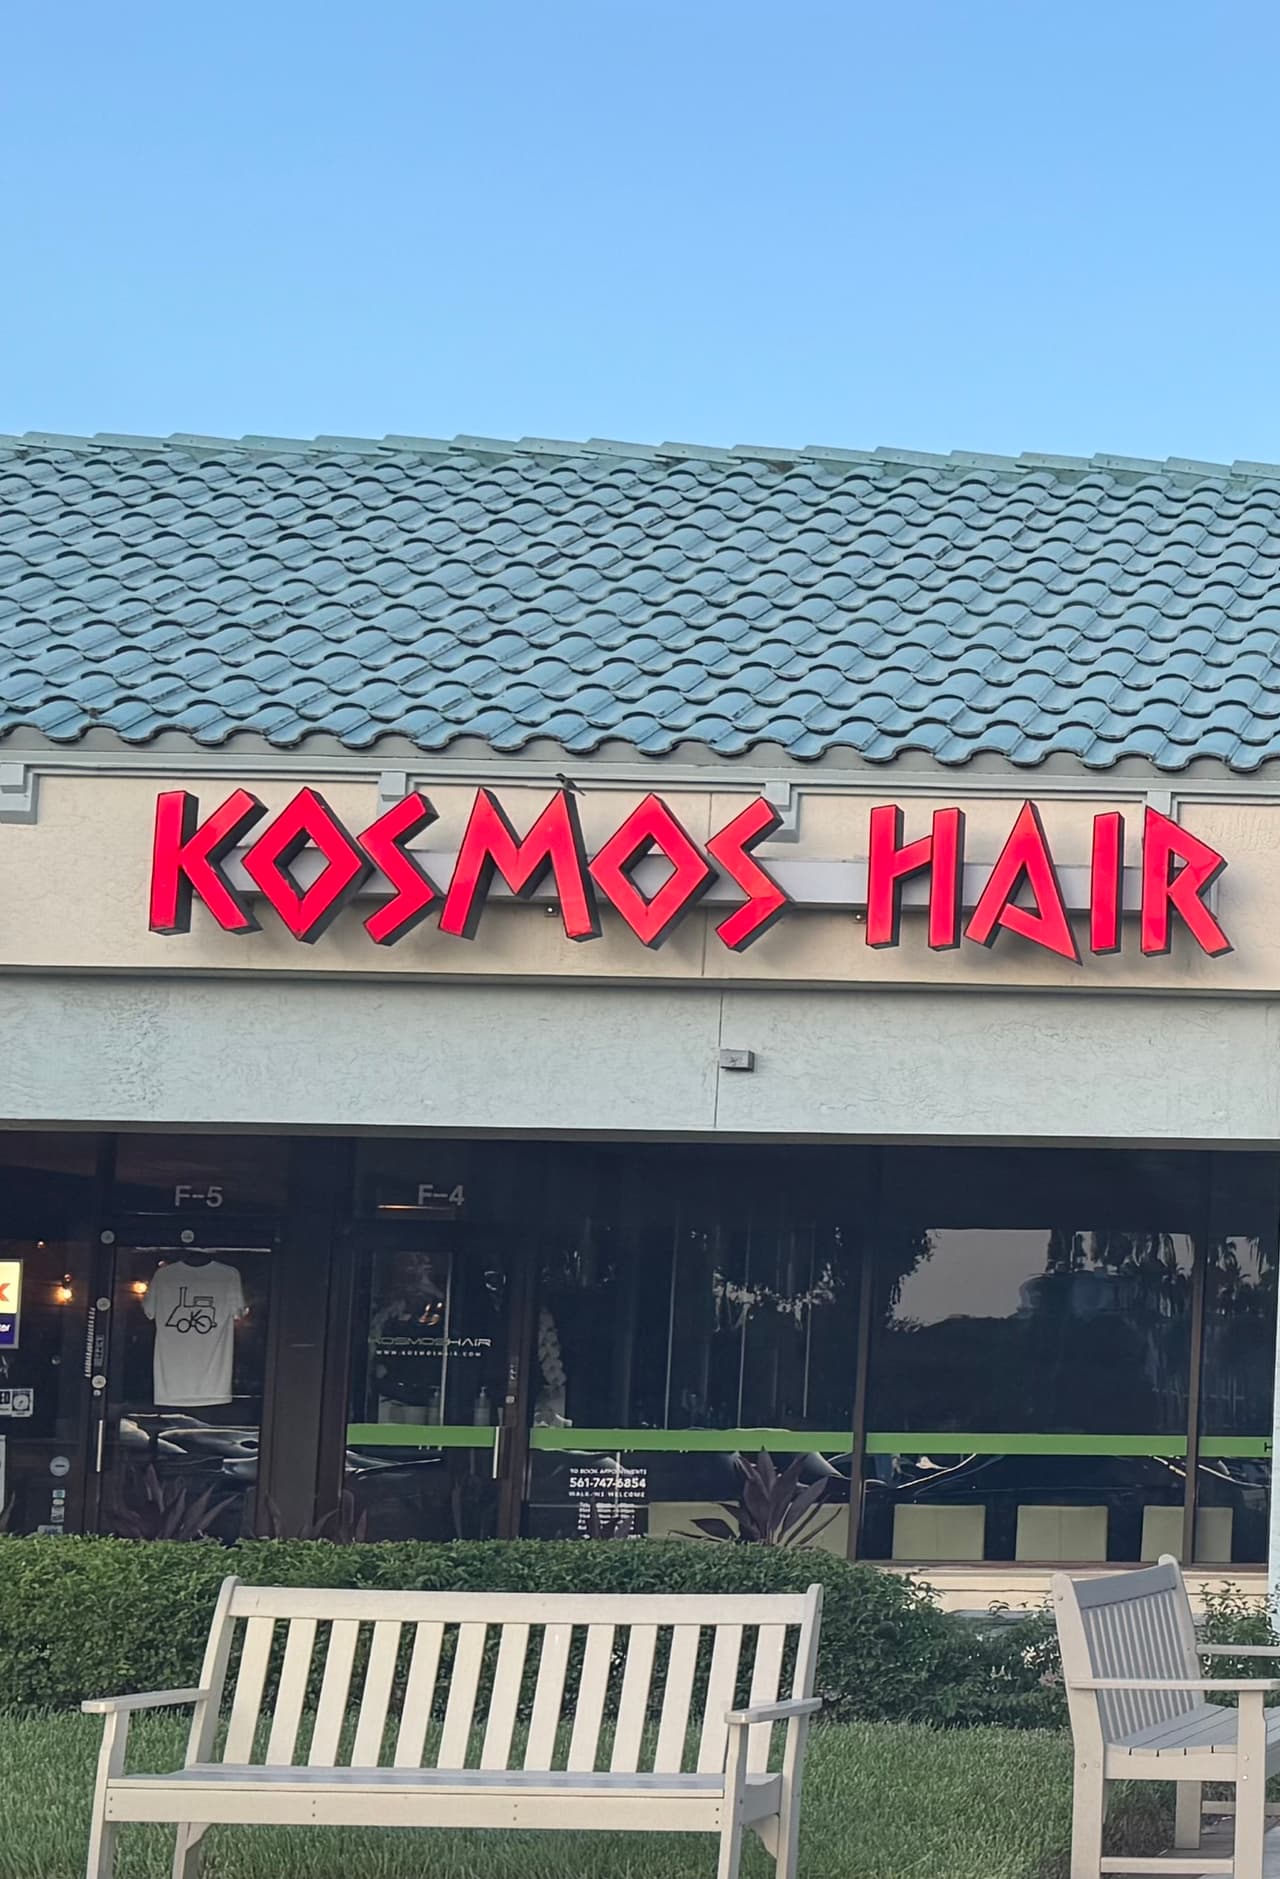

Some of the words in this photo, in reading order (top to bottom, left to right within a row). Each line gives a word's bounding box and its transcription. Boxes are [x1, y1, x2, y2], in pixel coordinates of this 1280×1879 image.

[149, 785, 793, 952] KOSMOS
[865, 799, 1235, 965] HAIR
[174, 1185, 223, 1208] F-5
[416, 1183, 465, 1206] F-4
[569, 1477, 646, 1488] 561-747-6854
